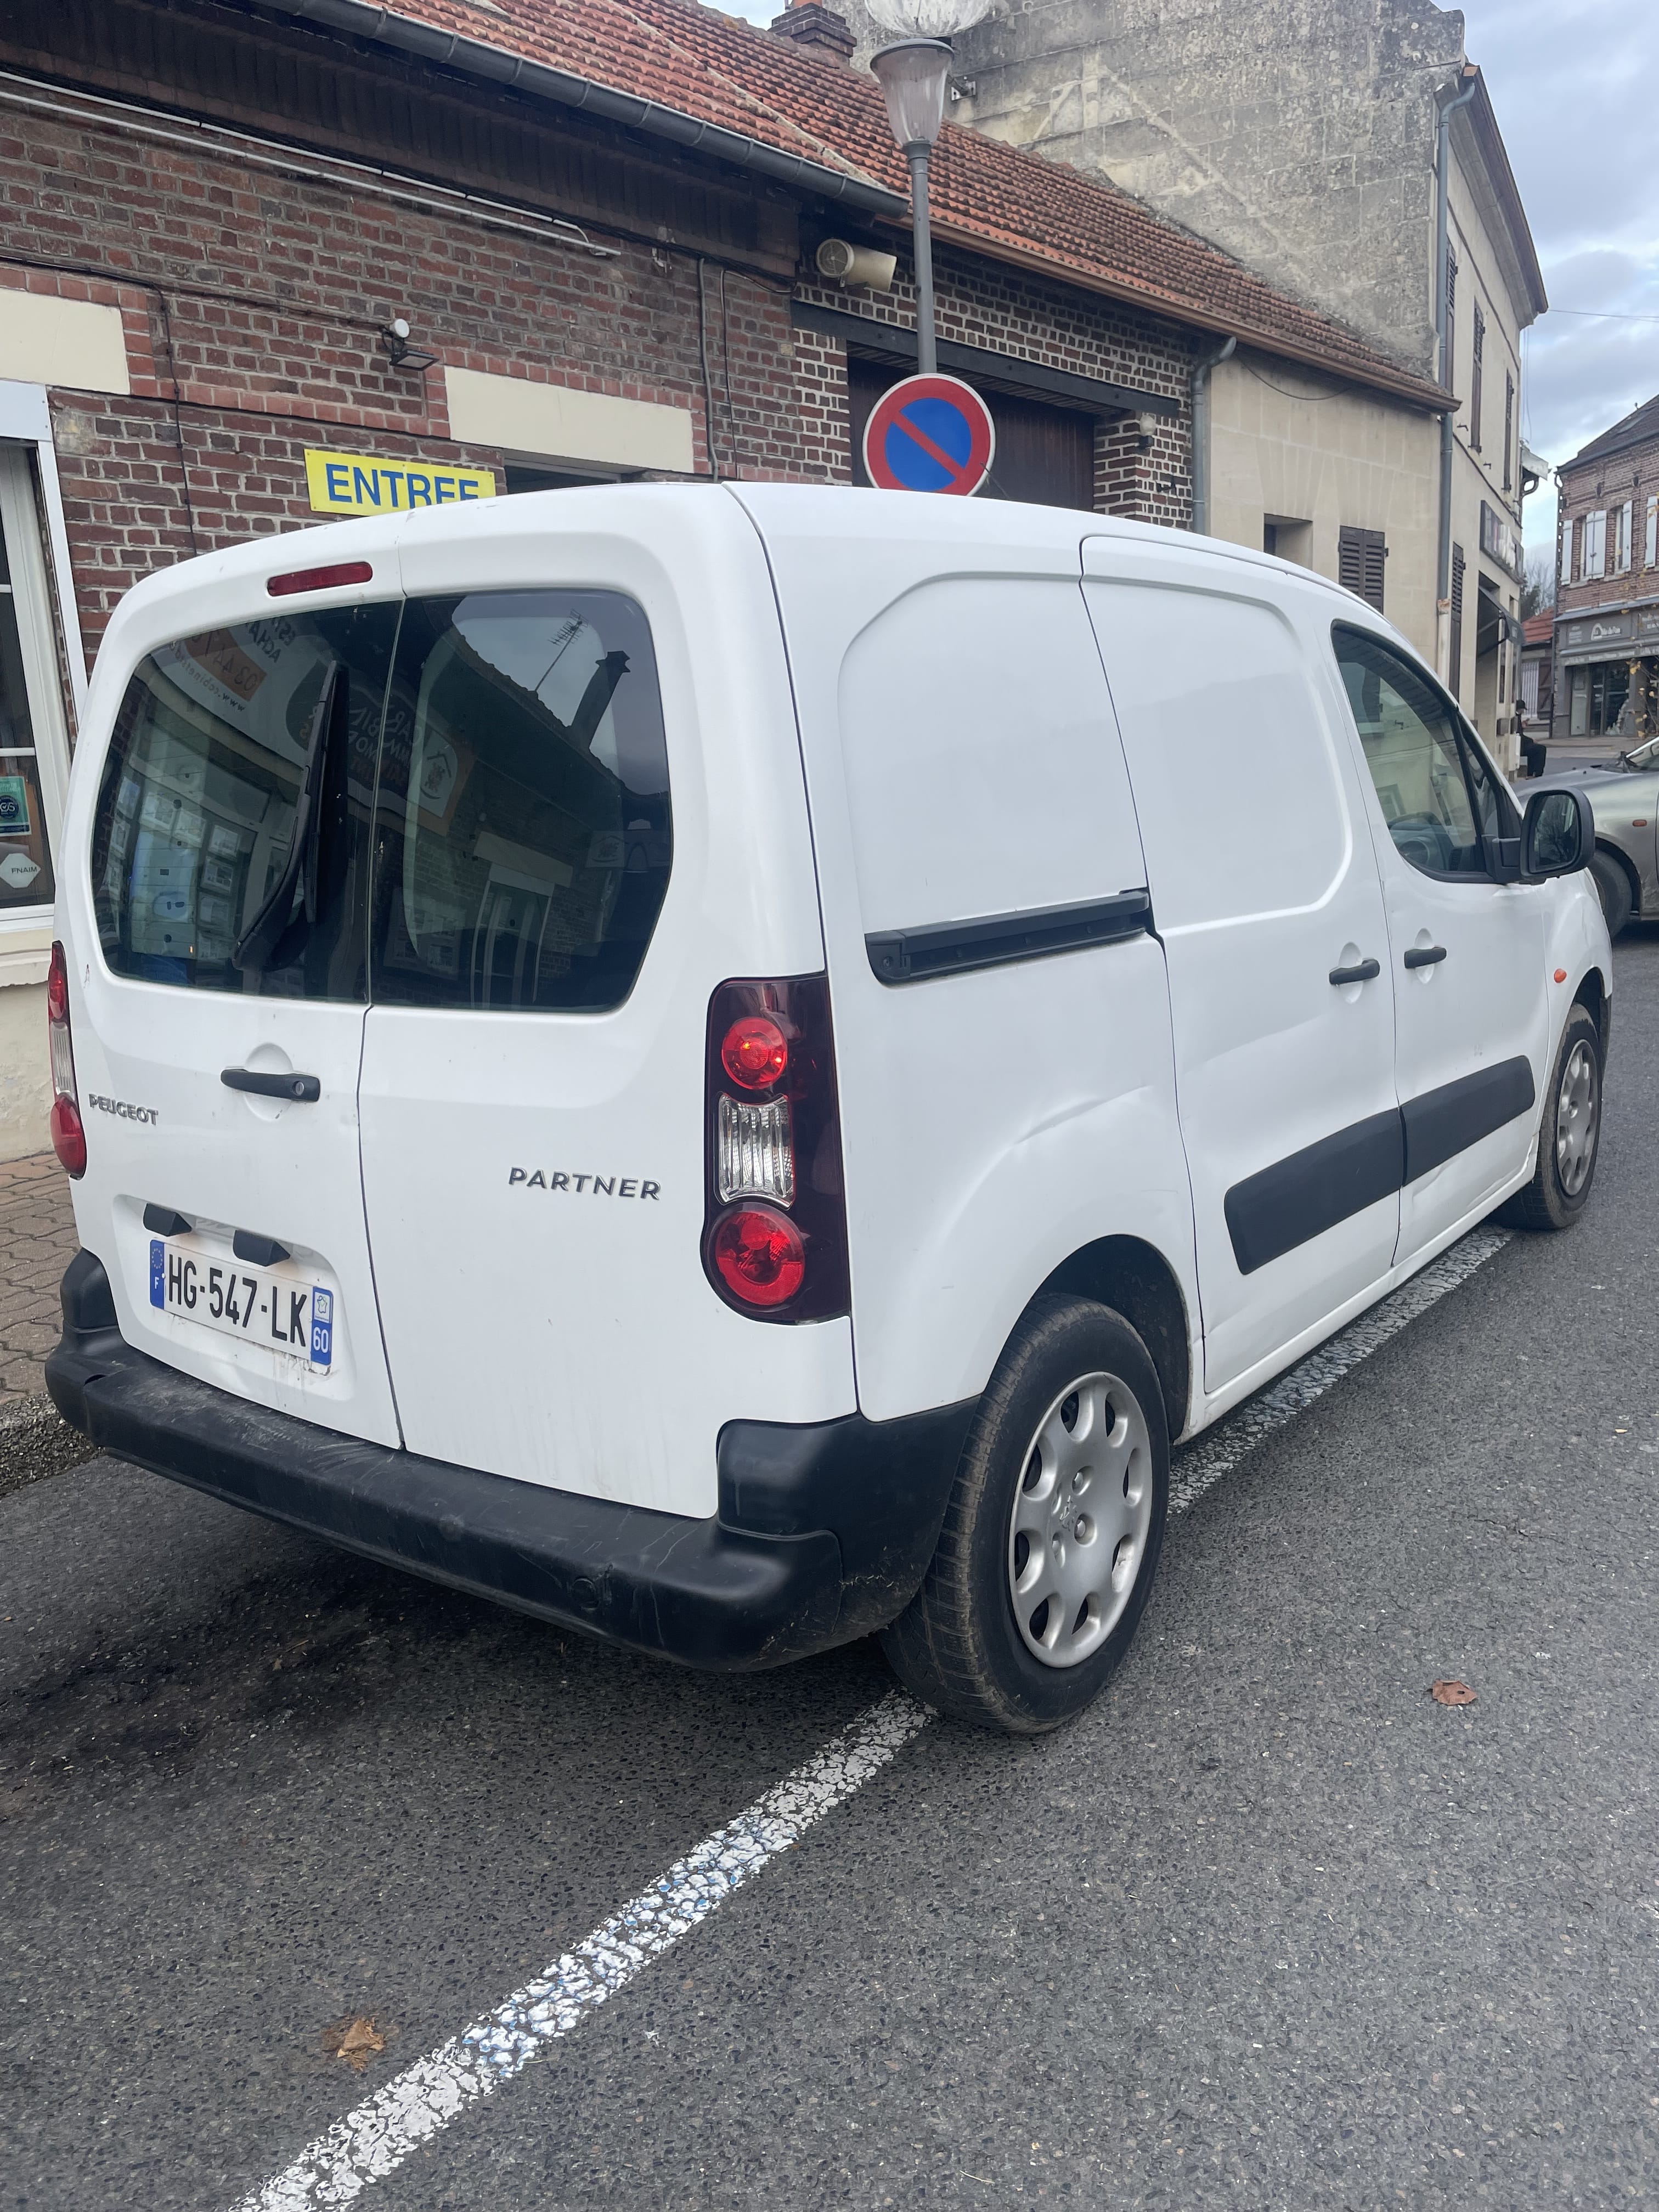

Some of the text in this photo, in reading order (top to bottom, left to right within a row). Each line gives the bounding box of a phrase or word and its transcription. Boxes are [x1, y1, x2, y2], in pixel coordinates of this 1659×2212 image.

[88, 1093, 159, 1126] PEUGEOT
[508, 1166, 661, 1201] PARTNER
[154, 1254, 329, 1353] F HG-547-LK 60
